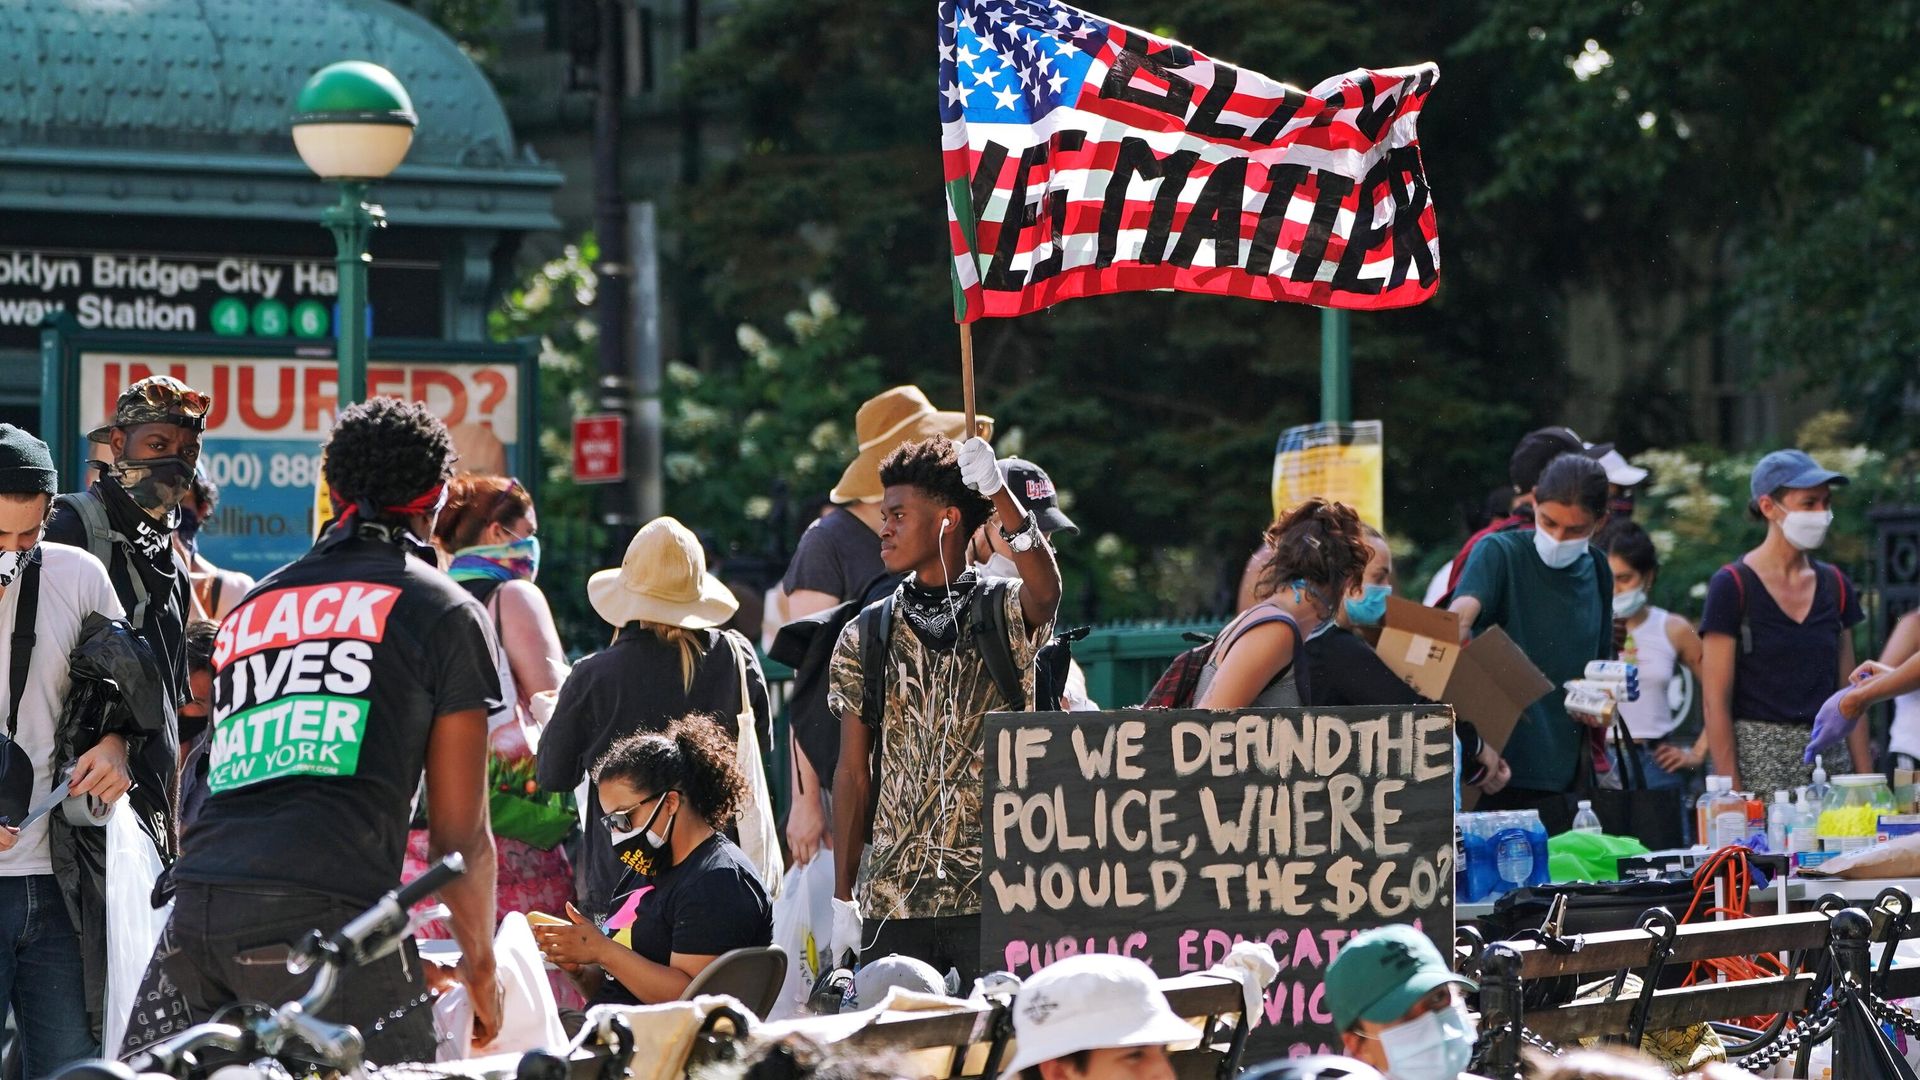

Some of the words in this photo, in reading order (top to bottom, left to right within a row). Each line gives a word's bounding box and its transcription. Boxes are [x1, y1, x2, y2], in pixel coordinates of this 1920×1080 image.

[1096, 136, 1438, 295] MATTER
[294, 262, 338, 296] Ha
[77, 293, 196, 331] Station
[220, 306, 239, 331] 4
[261, 308, 280, 335] 5
[301, 309, 319, 335] 6
[205, 453, 263, 490] 00)
[212, 586, 392, 664] BLACK
[213, 640, 374, 728] LIVES
[264, 742, 343, 772] YORK
[997, 726, 1053, 790] IF
[1071, 721, 1147, 781] WE
[993, 784, 1198, 860] POLICE,
[1199, 773, 1413, 857] WHERE
[989, 858, 1188, 915] WOULD
[1200, 857, 1317, 916] THE
[1179, 918, 1422, 975] EDCAT
